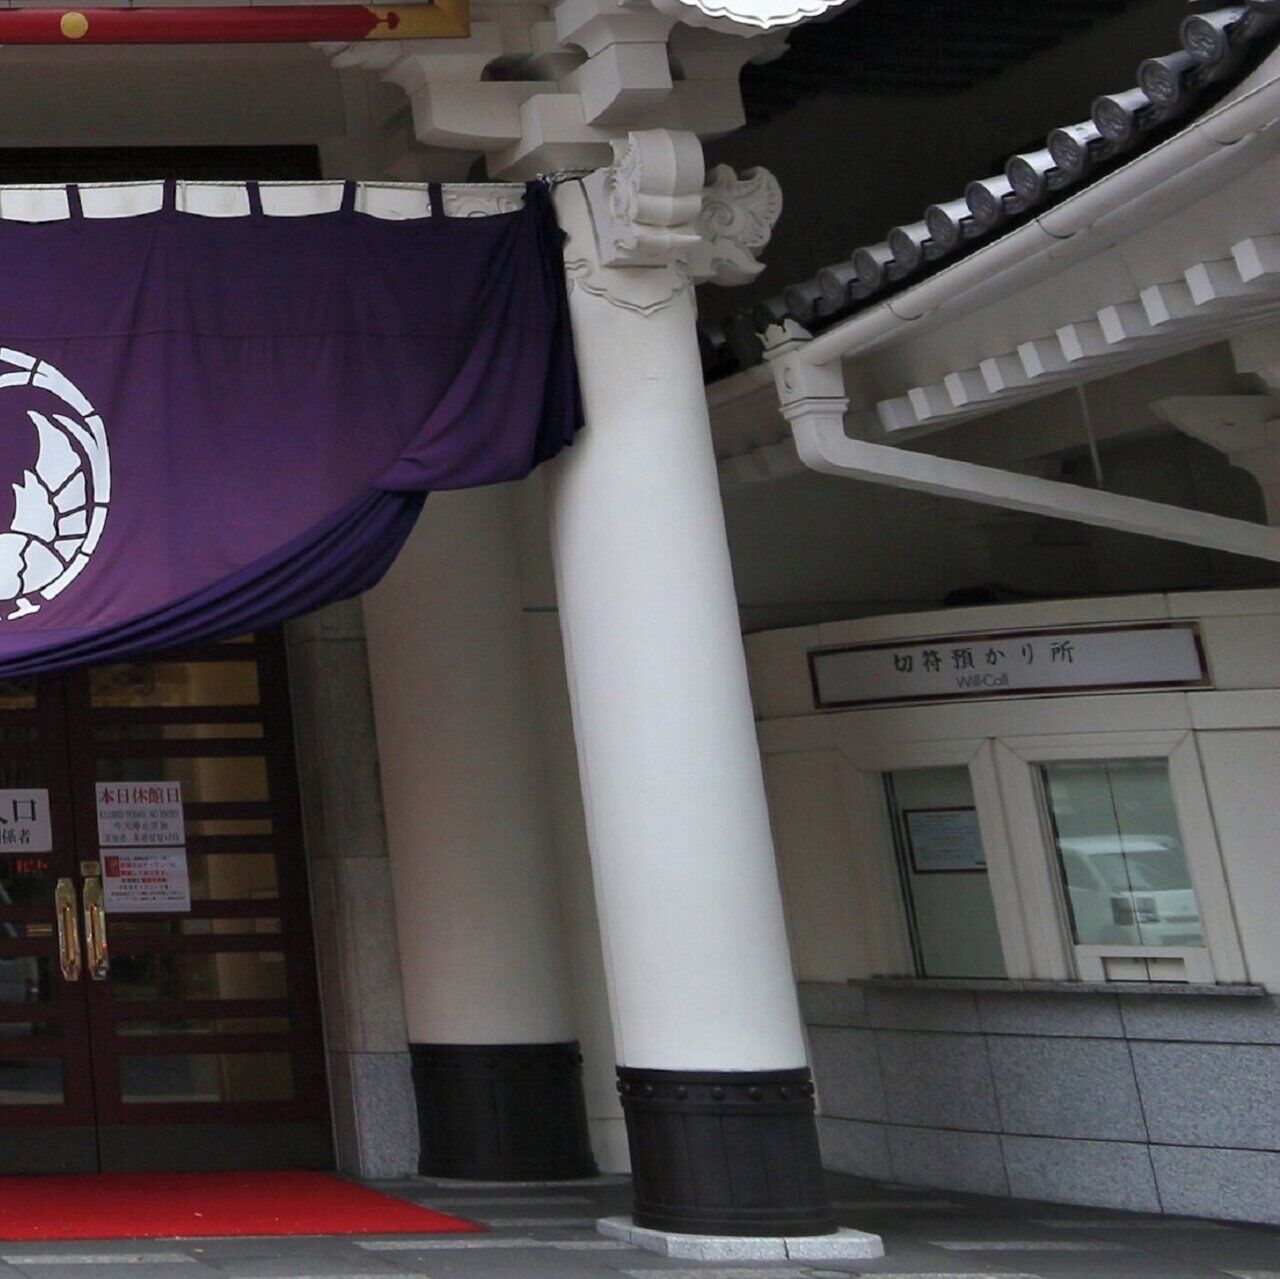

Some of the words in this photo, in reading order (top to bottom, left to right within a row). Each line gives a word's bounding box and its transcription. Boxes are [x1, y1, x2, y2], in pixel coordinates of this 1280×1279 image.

[893, 640, 1076, 673] 切符預かり所
[99, 787, 179, 804] 本日休館日
